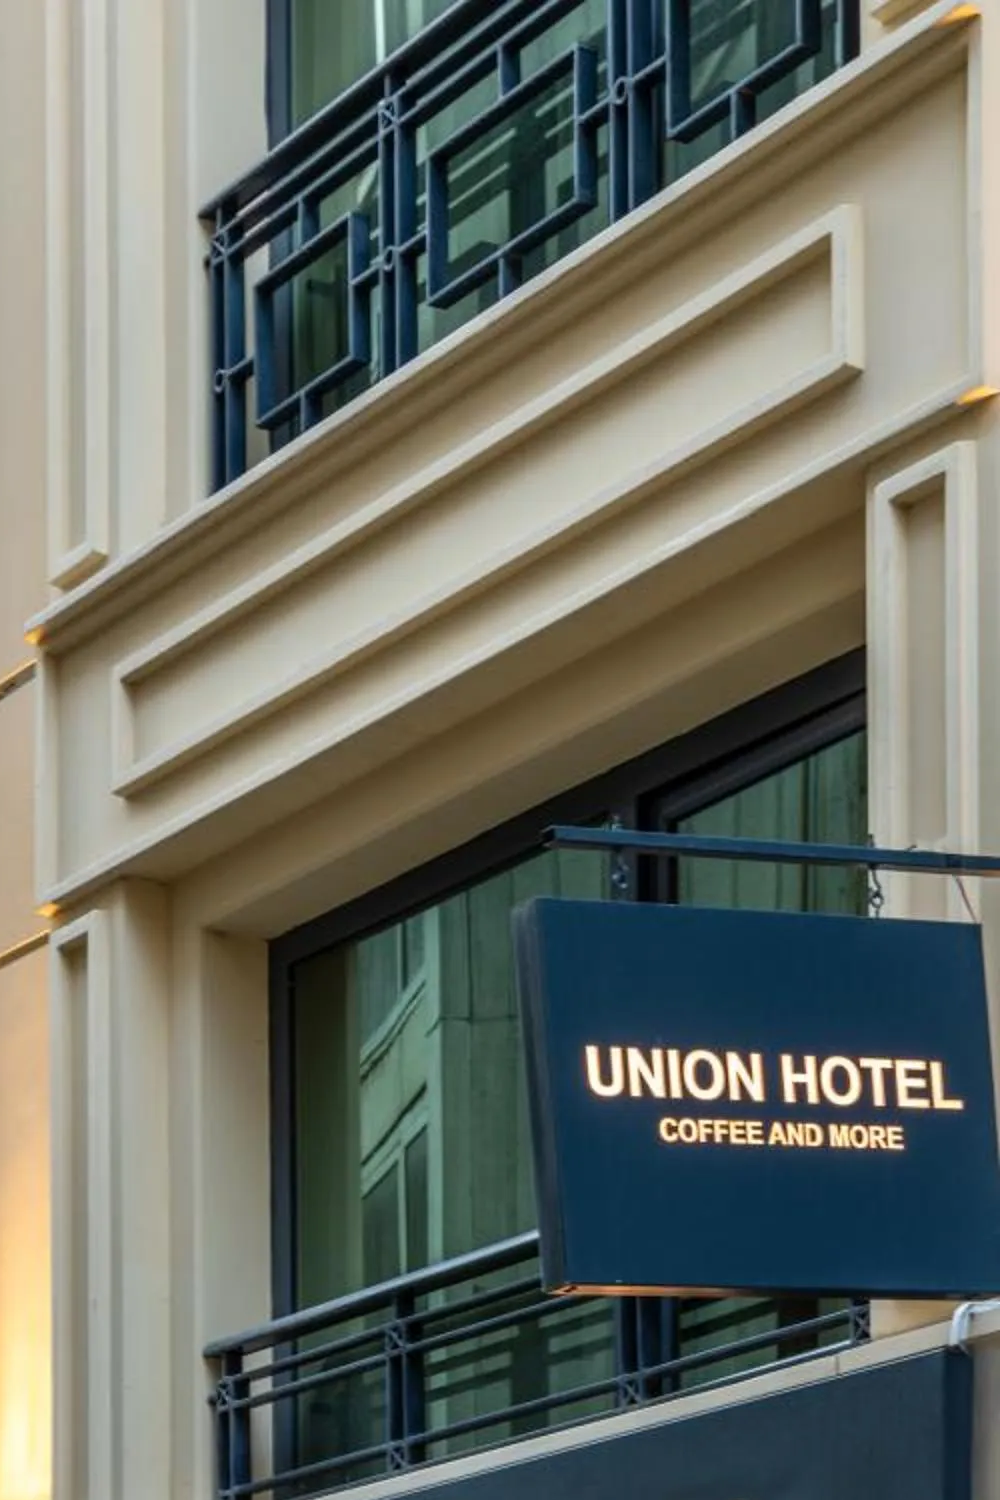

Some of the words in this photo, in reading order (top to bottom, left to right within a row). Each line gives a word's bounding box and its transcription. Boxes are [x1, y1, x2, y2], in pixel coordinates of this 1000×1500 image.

[585, 1044, 765, 1102] UNION
[780, 1053, 964, 1110] HOTEL
[659, 1117, 765, 1146] COFFEE
[767, 1121, 824, 1148] AND
[828, 1123, 905, 1151] MORE
